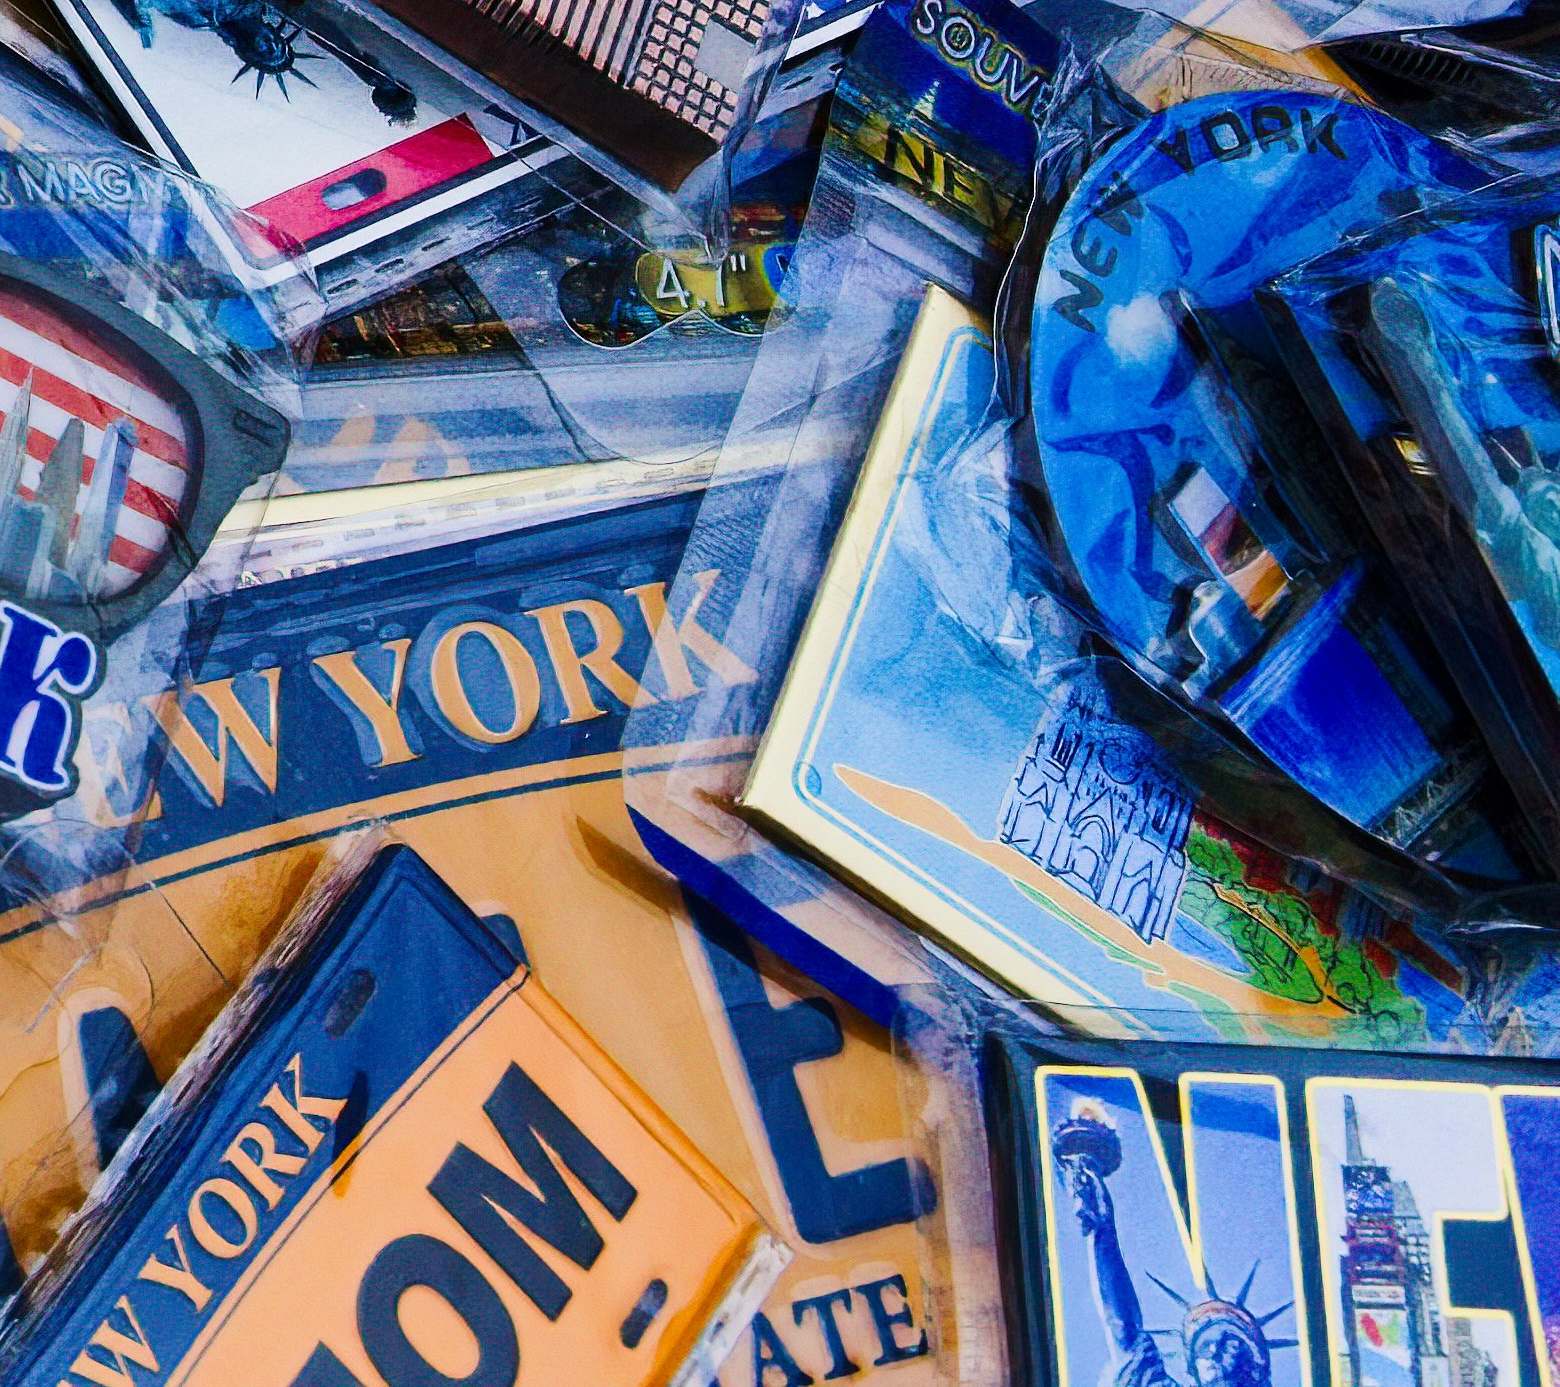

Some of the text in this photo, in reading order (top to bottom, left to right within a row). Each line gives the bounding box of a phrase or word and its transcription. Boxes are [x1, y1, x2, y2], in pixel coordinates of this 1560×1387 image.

[1054, 108, 1350, 333] NEW YORK
[305, 570, 730, 776] YORK
